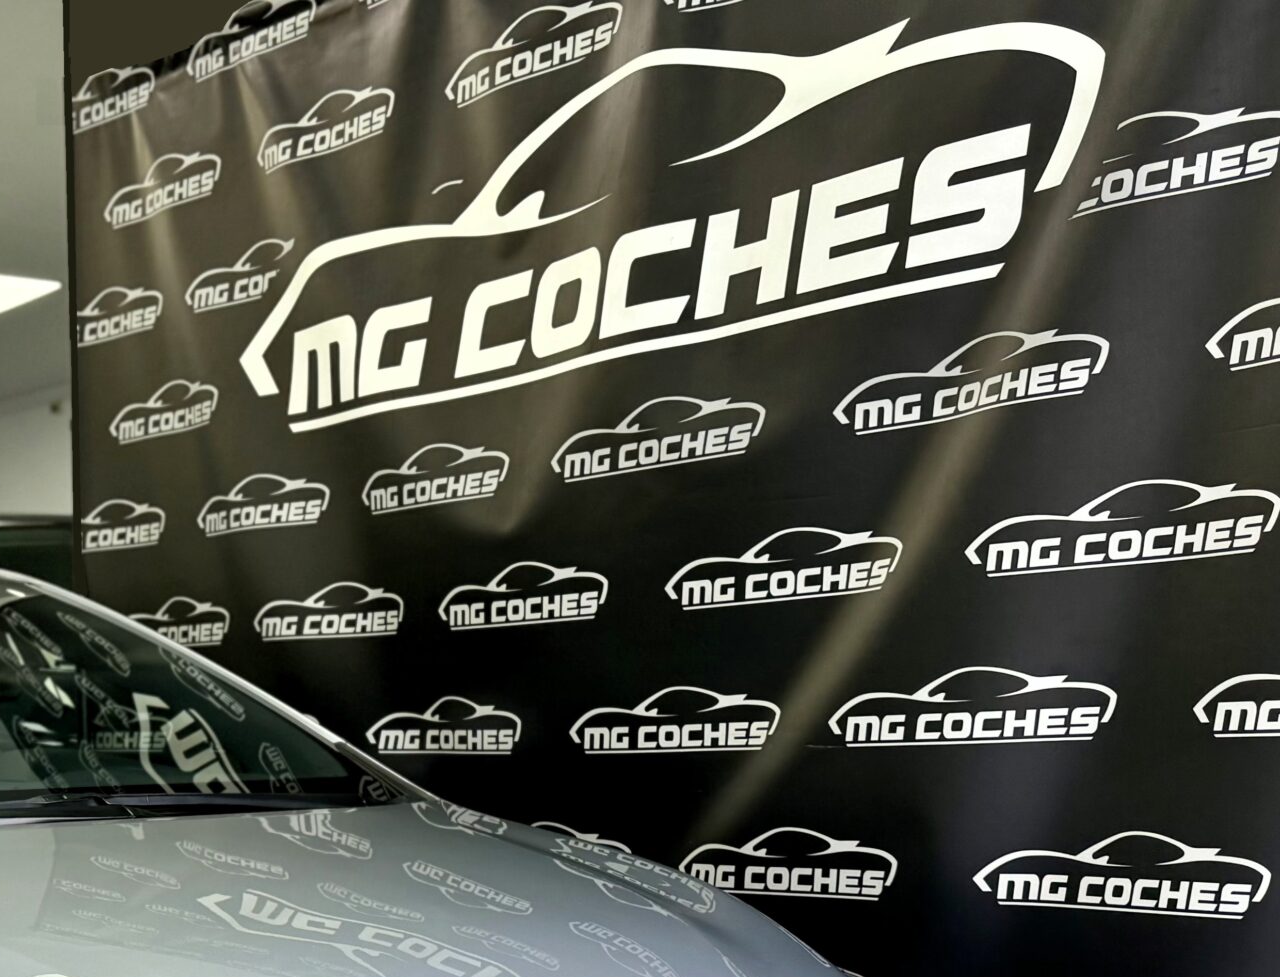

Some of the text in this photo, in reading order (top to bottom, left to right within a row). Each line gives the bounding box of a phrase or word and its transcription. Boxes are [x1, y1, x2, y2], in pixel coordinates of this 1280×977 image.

[195, 10, 311, 79] MG COCHES
[457, 21, 614, 104] MG COCHES
[80, 82, 151, 127] COCHES
[264, 107, 388, 170] MG COCHES
[113, 170, 215, 226] MG COCHES
[288, 123, 1031, 415] MG COCHES
[193, 283, 230, 309] MG
[83, 305, 157, 343] COCHES
[854, 357, 1092, 431] MG COCHES
[119, 400, 211, 442] MG COCHES
[563, 422, 753, 477] MG COCHES
[371, 469, 502, 511] MG COCHES
[85, 522, 161, 549] COCHES
[205, 500, 323, 534] MG COCHES
[986, 515, 1265, 572] MG COCHES
[681, 559, 891, 607] MG COCHES
[262, 613, 398, 637] MG COCHES
[450, 591, 601, 627] MG COCHES
[378, 729, 514, 751] MG COCHES
[584, 721, 769, 750] MG COCHES
[846, 706, 1102, 742] MG COCHES
[744, 867, 885, 895] COCHES
[997, 872, 1253, 914] MG COCHES
